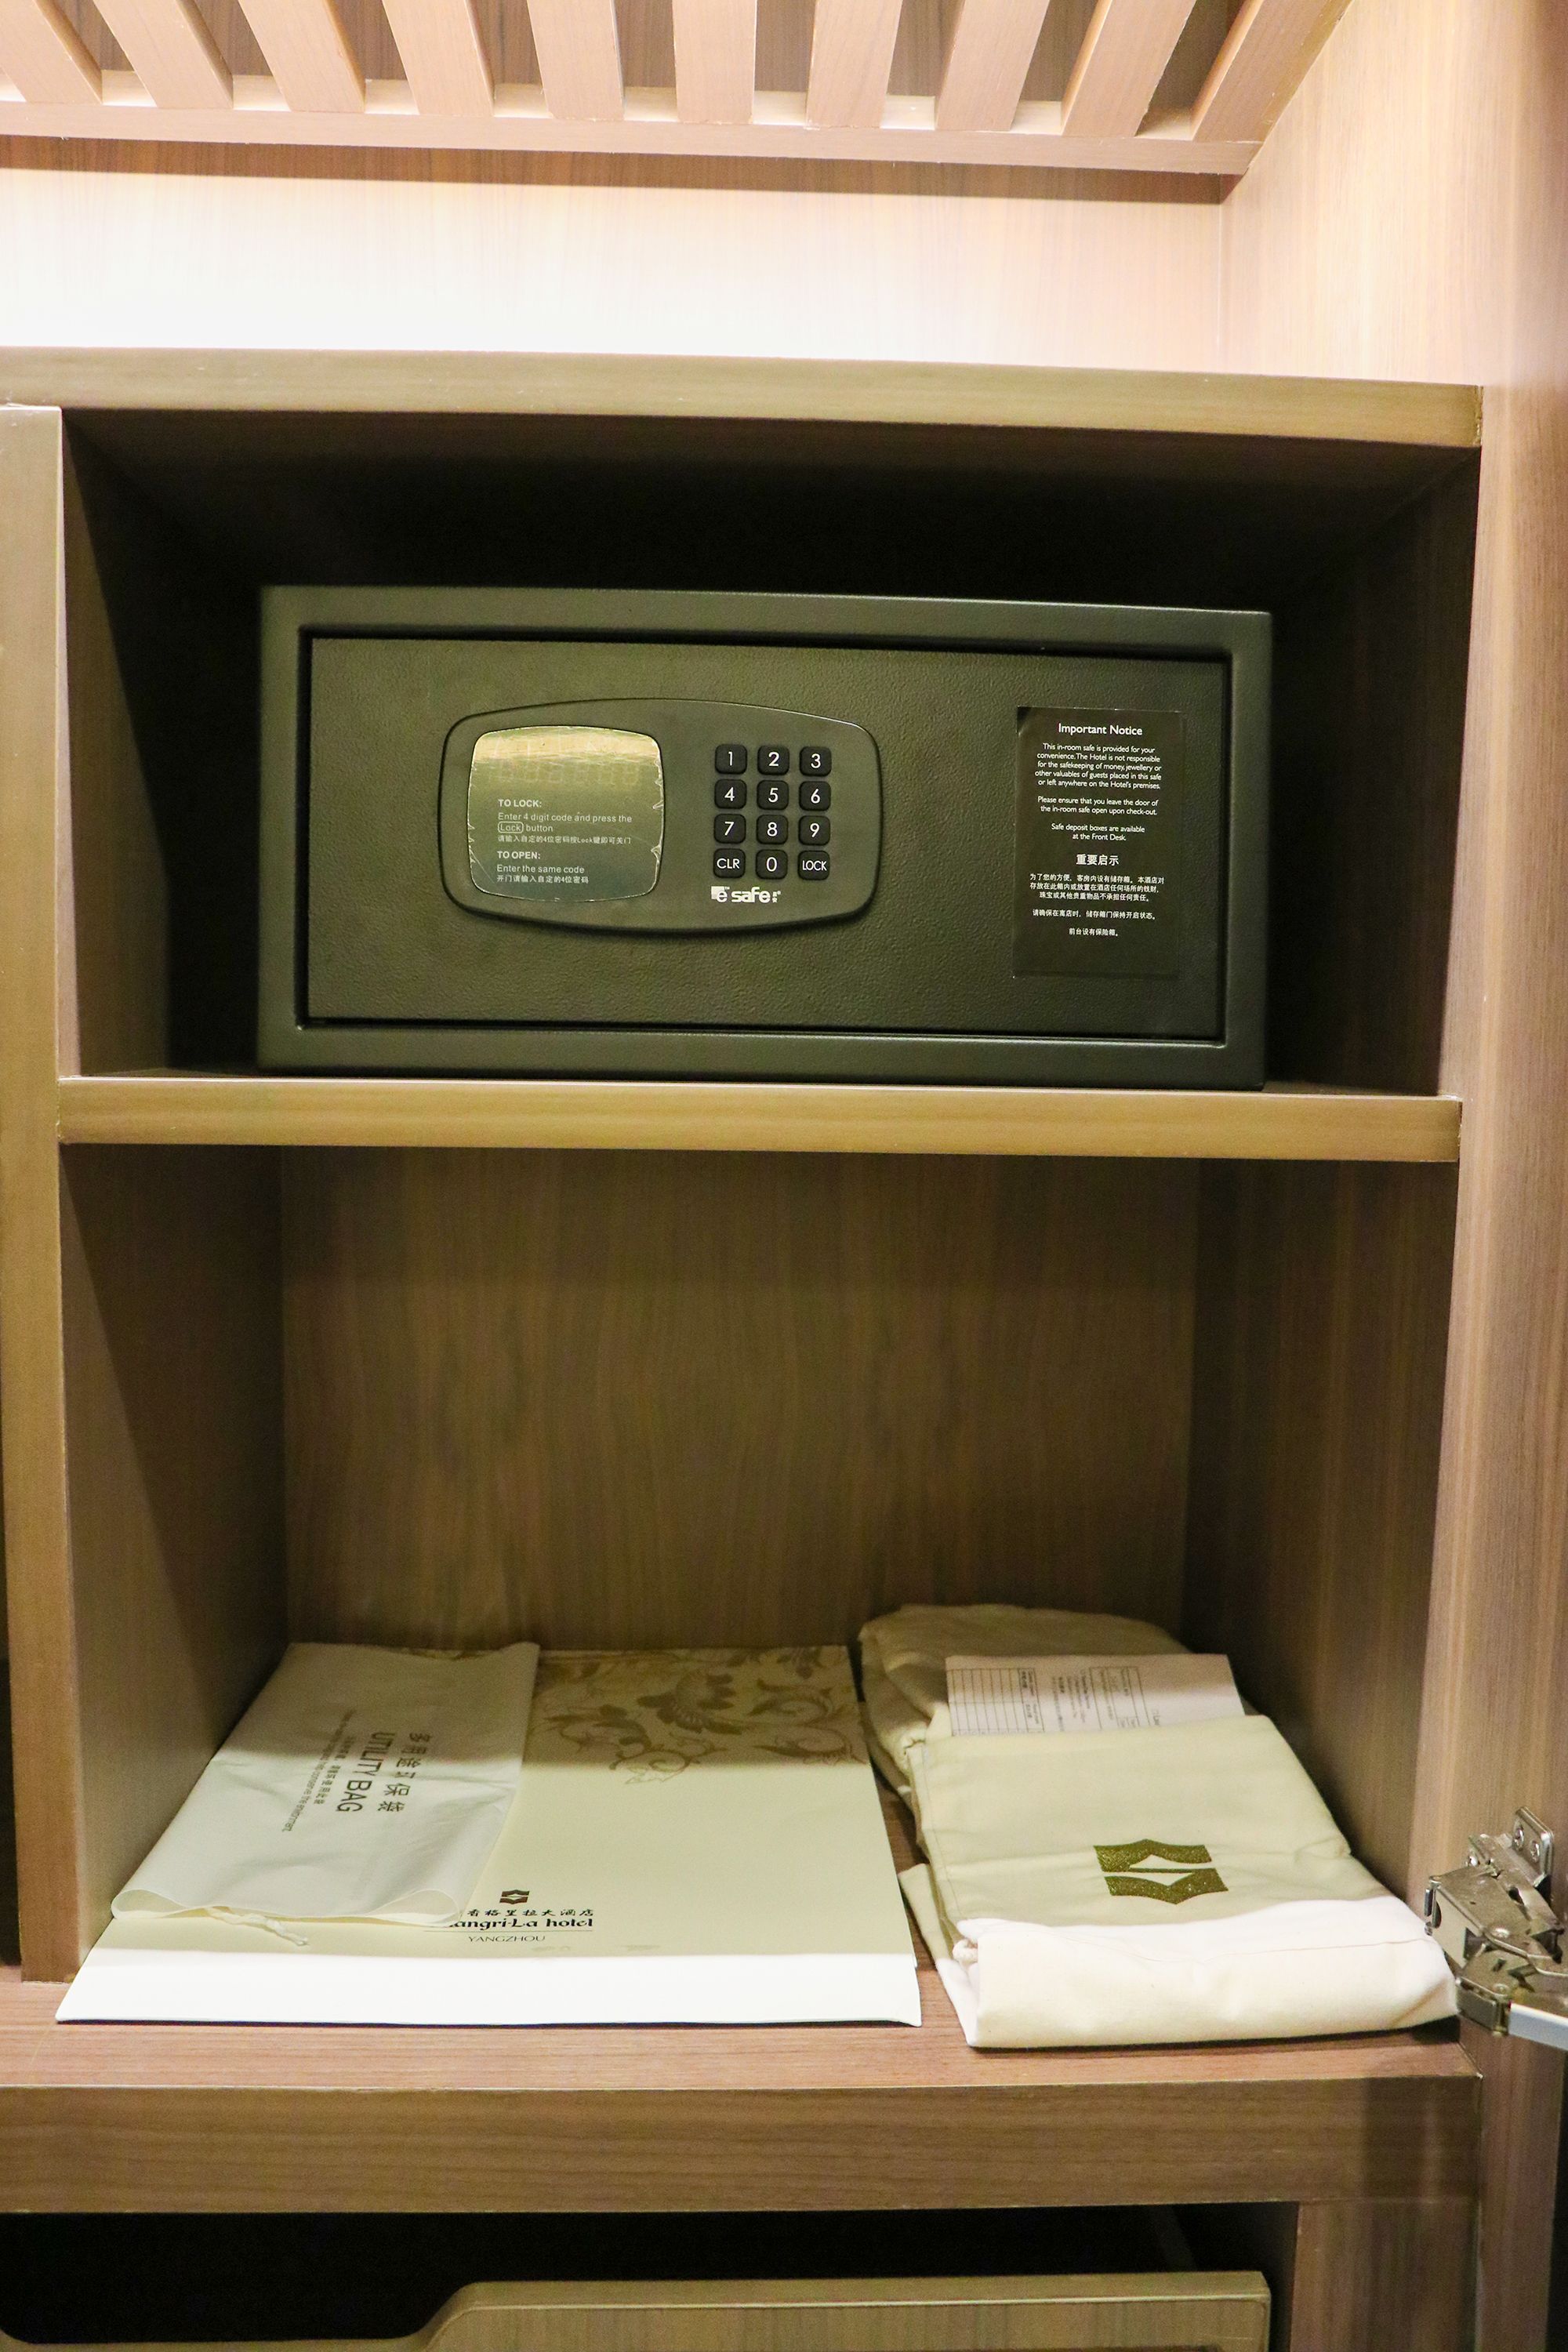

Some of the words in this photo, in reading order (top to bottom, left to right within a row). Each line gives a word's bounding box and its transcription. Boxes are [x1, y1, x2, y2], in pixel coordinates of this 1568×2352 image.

[1058, 723, 1107, 735] Important
[1110, 725, 1142, 735] Notice
[728, 752, 732, 766] 1
[768, 752, 779, 766] 2
[811, 753, 821, 768] 3
[1126, 764, 1152, 772] jewellery
[724, 787, 735, 801] 4
[768, 788, 779, 803] 5
[811, 789, 820, 804] 6
[531, 814, 550, 823] digit
[593, 816, 616, 825] press
[500, 823, 521, 832] Lock
[725, 822, 734, 836] 7
[767, 822, 778, 837] 8
[810, 823, 819, 837] 9
[717, 858, 740, 869] CLR
[767, 857, 777, 872] 0
[803, 860, 827, 871] LOCK
[1076, 854, 1119, 866] 重要启示
[352, 1732, 396, 1777] UTILITY
[336, 1780, 372, 1812] BAG
[546, 1918, 593, 1927] hotel
